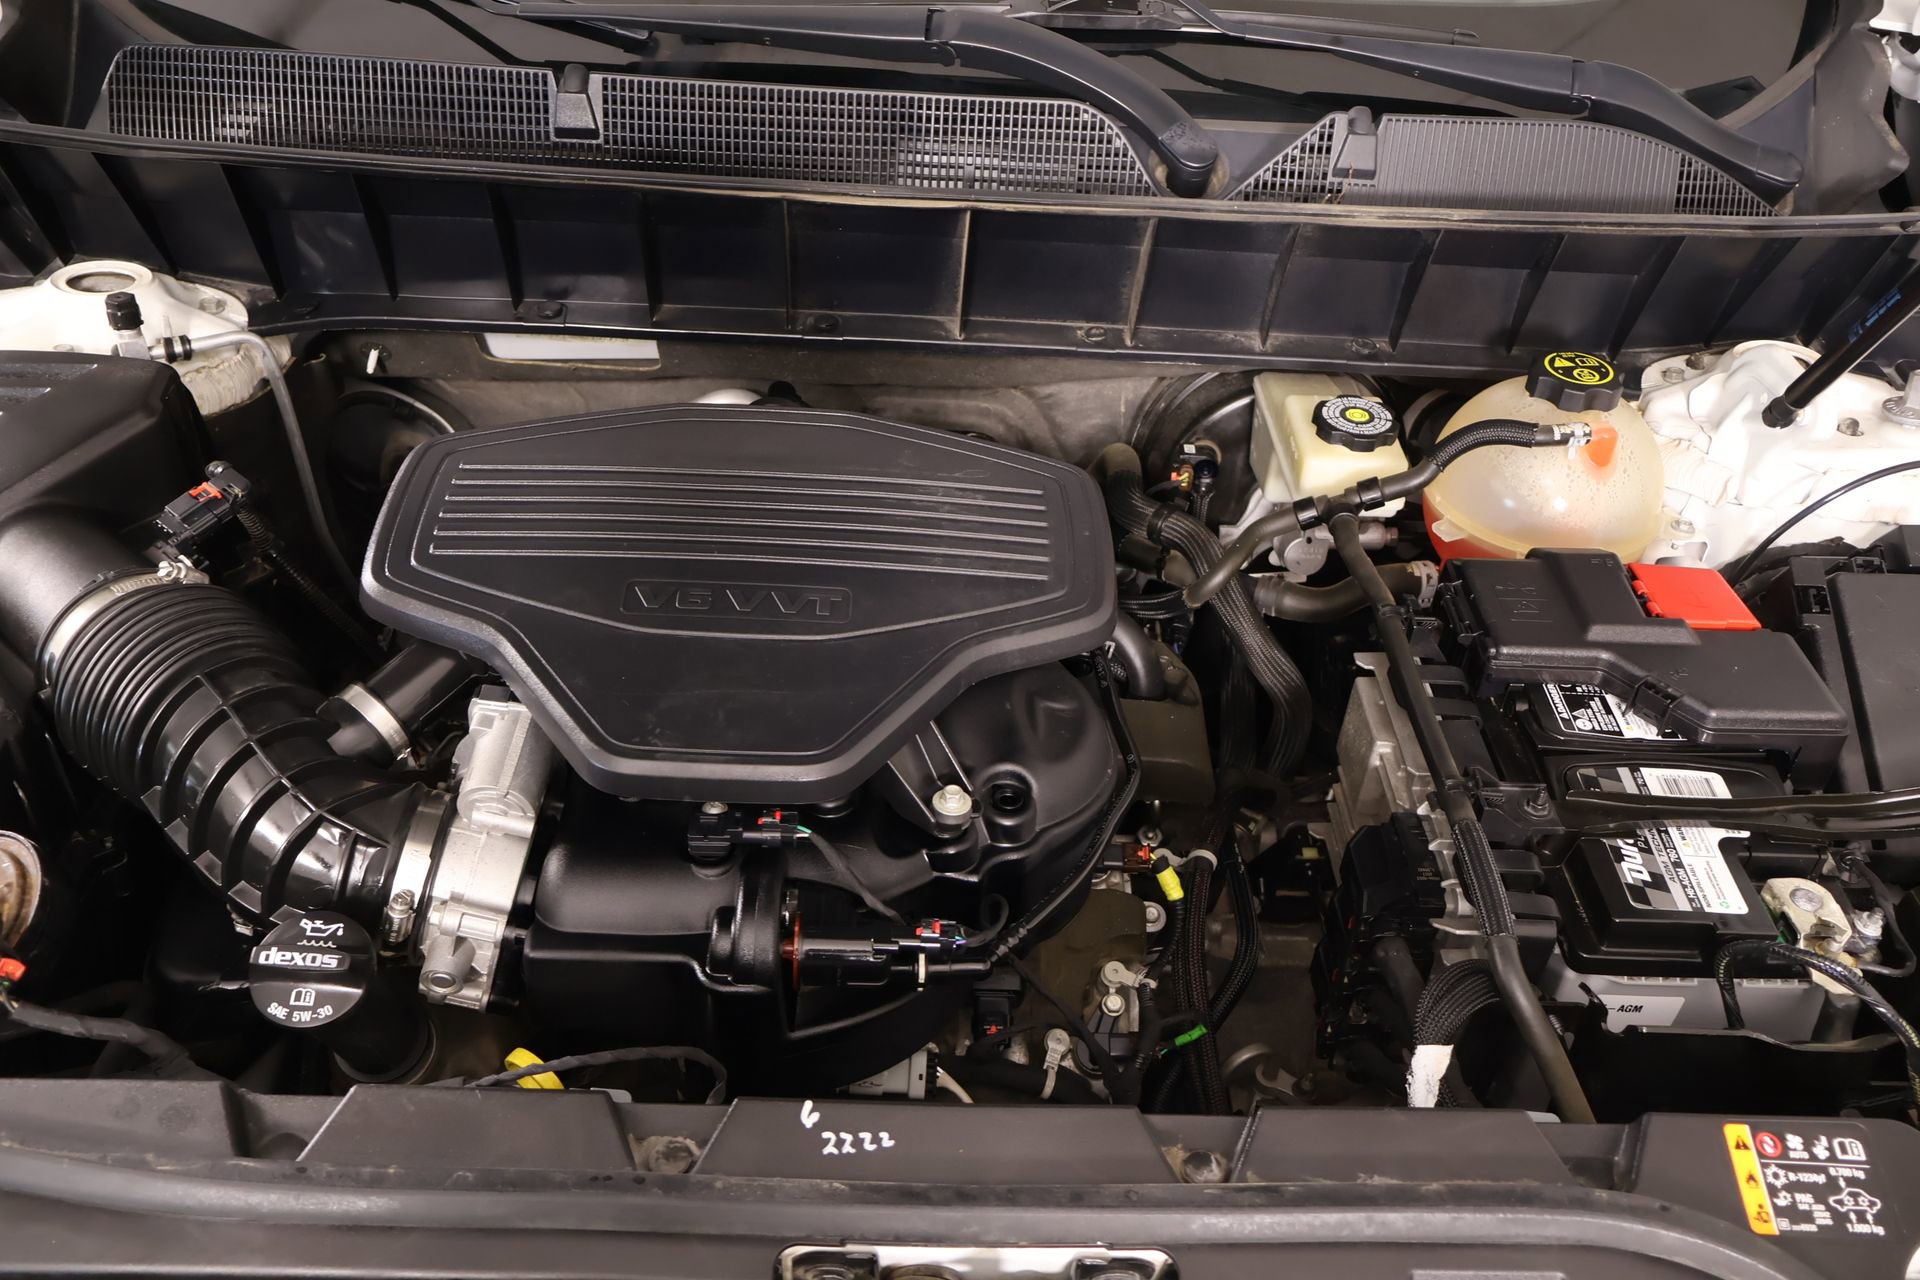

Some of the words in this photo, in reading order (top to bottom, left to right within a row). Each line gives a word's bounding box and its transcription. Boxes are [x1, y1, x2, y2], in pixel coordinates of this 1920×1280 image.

[635, 586, 712, 610] V6
[726, 589, 842, 615] VVT
[1667, 848, 1681, 863] 760
[1661, 861, 1678, 884] AGM
[1675, 867, 1697, 900] H6-AGM
[258, 946, 343, 969] dexos
[267, 1002, 290, 1020] SAE
[292, 1004, 334, 1022] 5W-30
[821, 1131, 896, 1155] 2222
